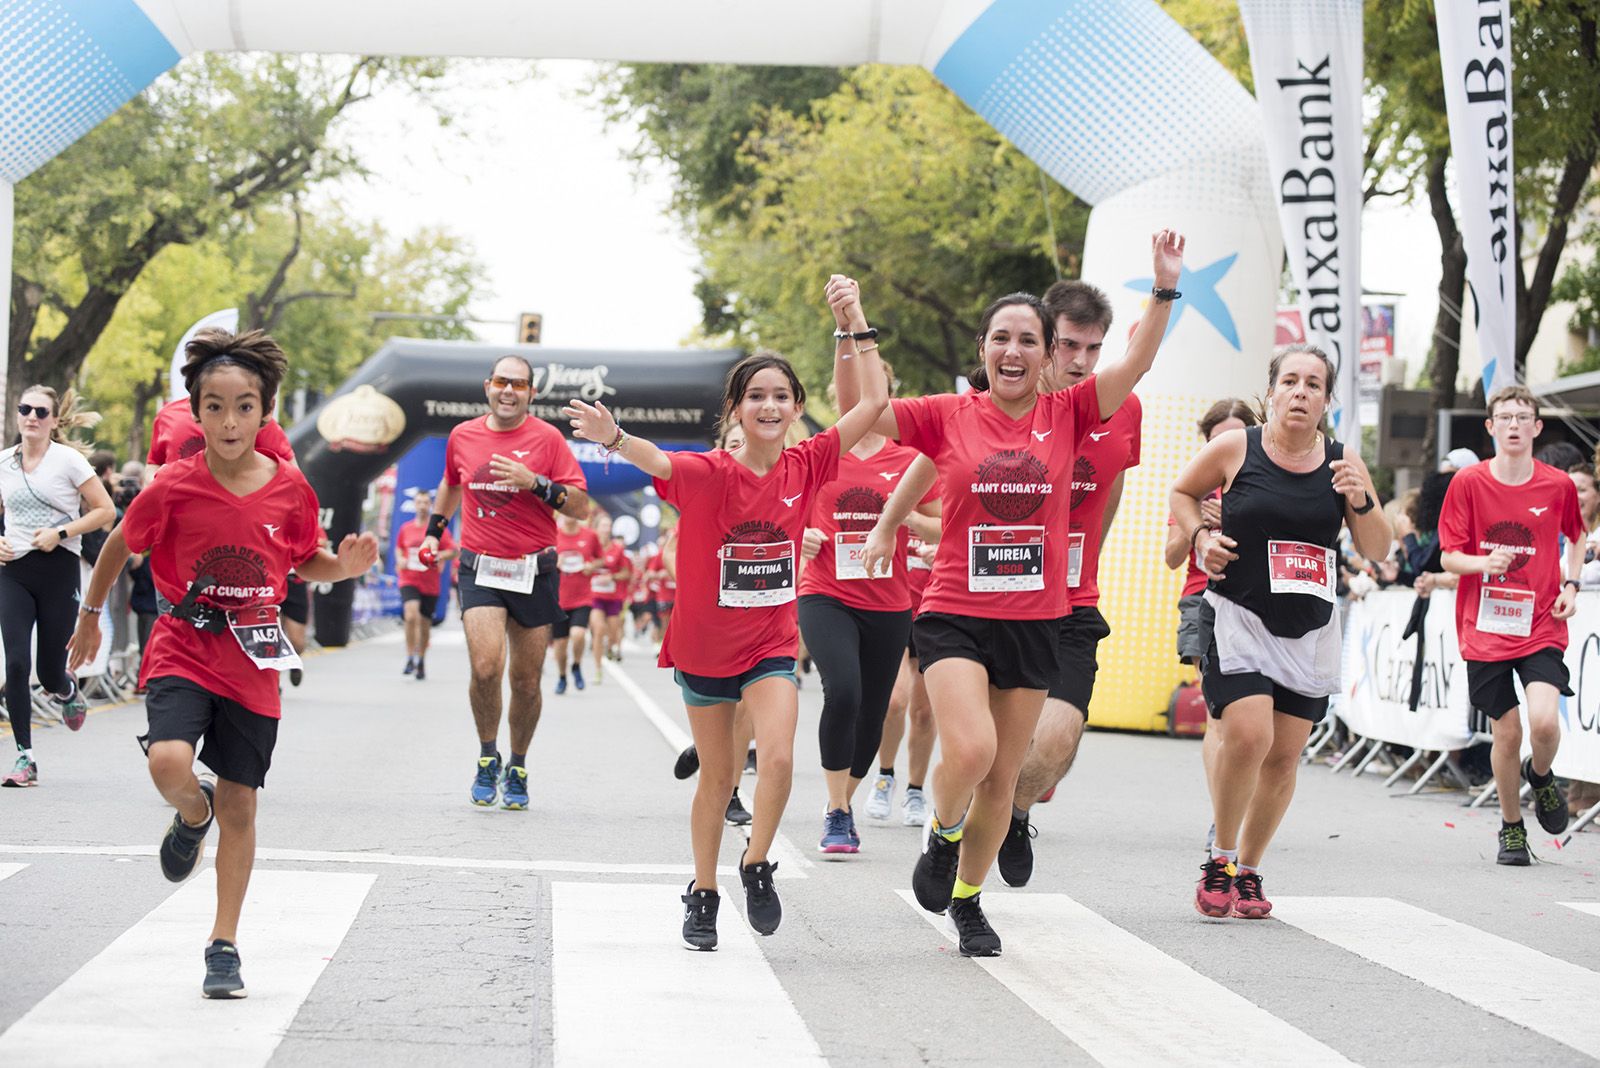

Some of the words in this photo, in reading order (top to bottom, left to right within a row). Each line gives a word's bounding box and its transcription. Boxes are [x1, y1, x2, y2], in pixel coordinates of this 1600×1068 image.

[971, 483, 999, 493] SANT
[832, 512, 852, 520] SANT
[200, 544, 237, 563] CURSA
[987, 547, 1032, 561] MIREIA
[489, 559, 518, 572] DAVID
[738, 563, 783, 575] MARTINA
[995, 563, 1024, 575] 3508
[1285, 557, 1319, 572] PILAR
[753, 579, 768, 589] 71
[252, 627, 279, 643] ALEX
